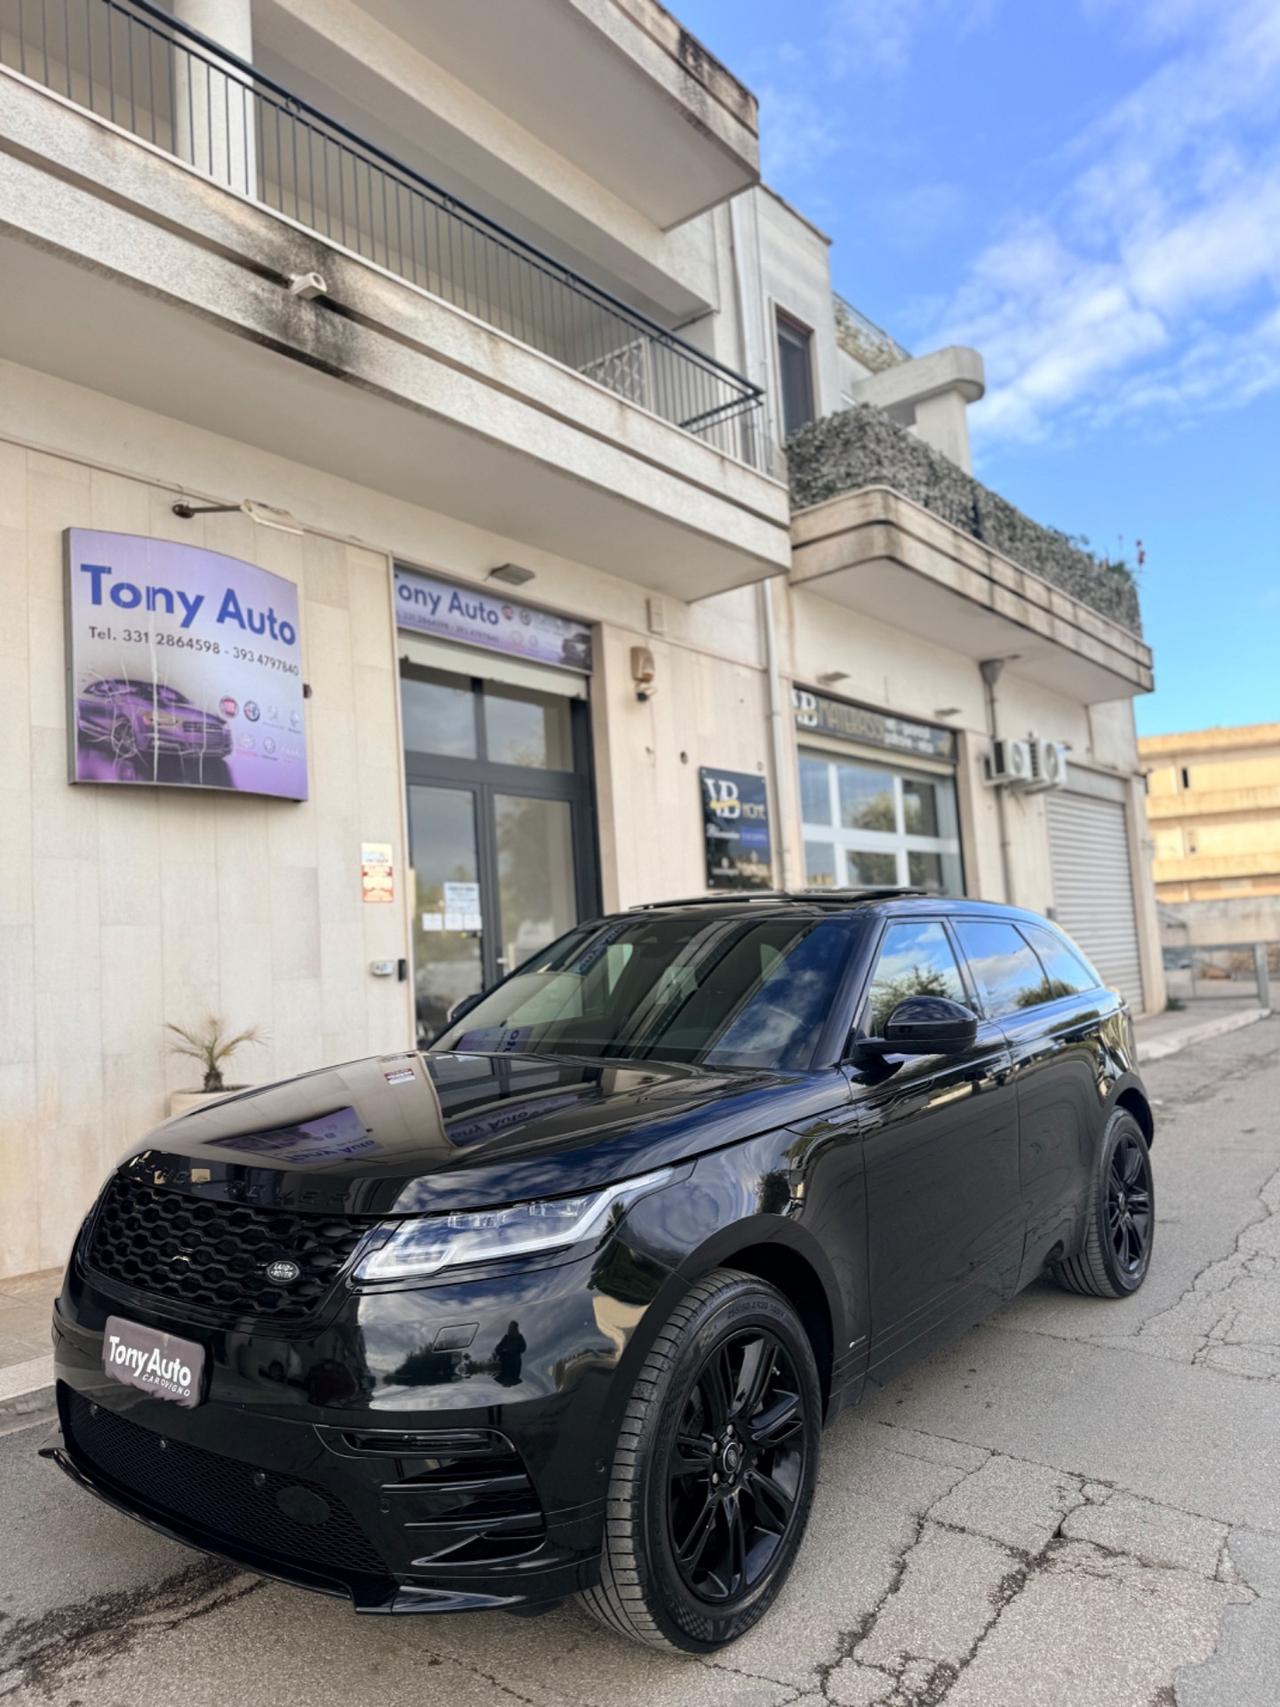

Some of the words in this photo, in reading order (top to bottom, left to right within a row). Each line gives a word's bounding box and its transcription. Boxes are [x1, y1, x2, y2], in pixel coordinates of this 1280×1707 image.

[81, 564, 204, 628] Tony
[216, 588, 296, 645] Auto
[395, 574, 442, 616] ony
[449, 591, 499, 625] Auto
[88, 626, 117, 641] Tel.
[123, 629, 149, 644] 331
[155, 632, 221, 655] 2864598
[233, 646, 255, 662] 393
[142, 1373, 191, 1397] CAROVIGNO
